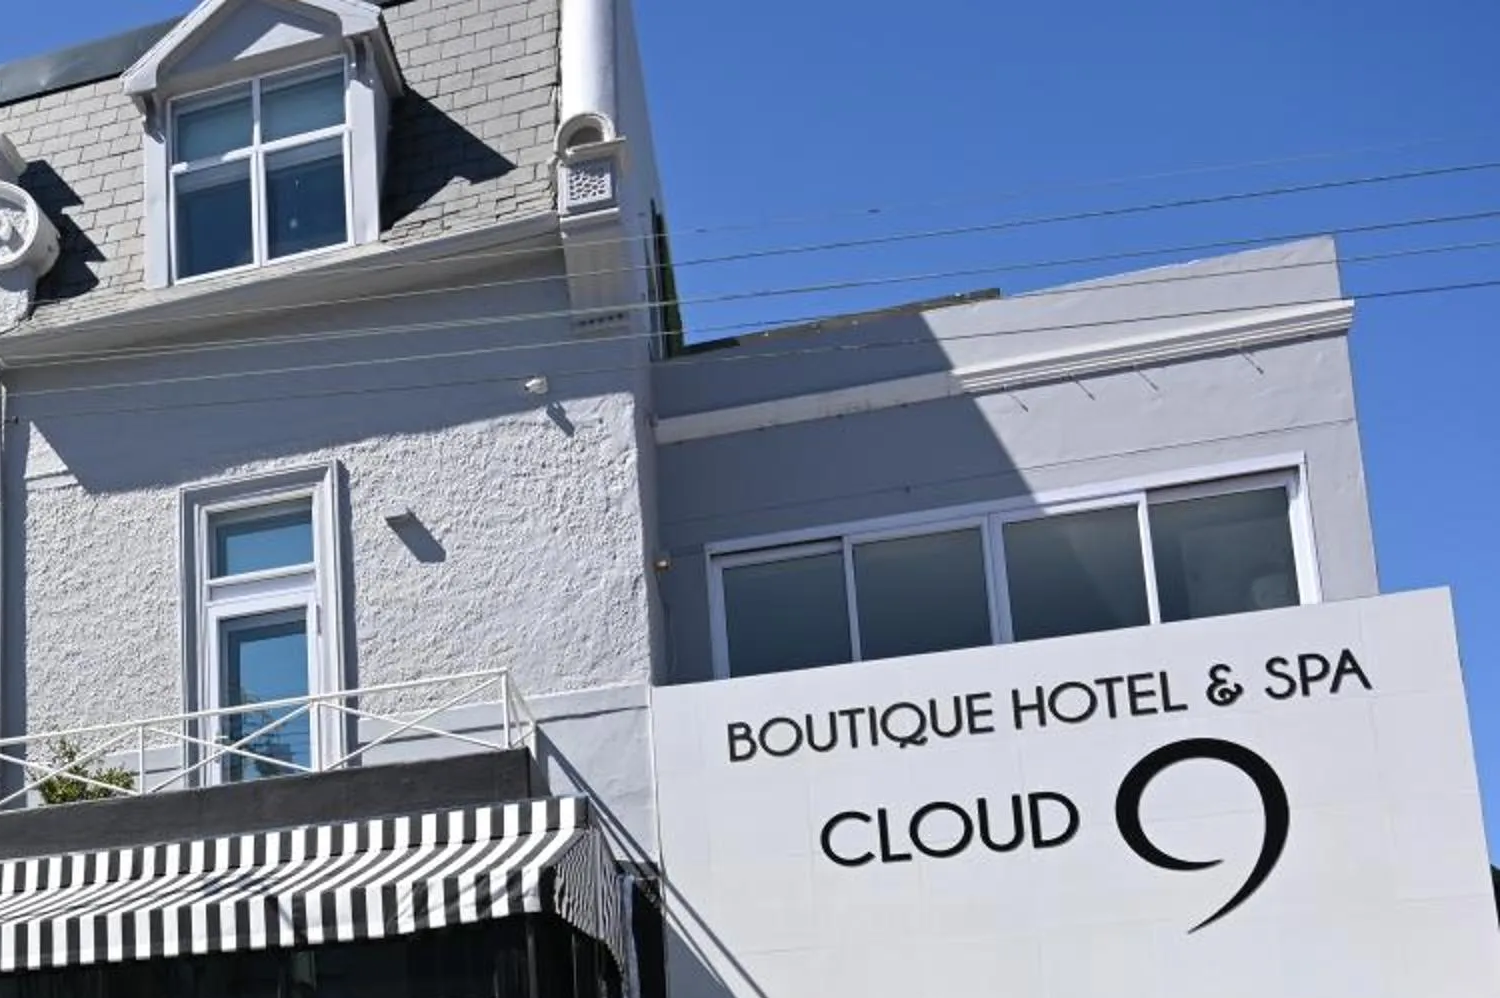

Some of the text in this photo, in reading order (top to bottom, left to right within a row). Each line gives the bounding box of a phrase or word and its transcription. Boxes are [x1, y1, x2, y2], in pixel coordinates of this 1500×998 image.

[727, 648, 1373, 763] BOUTIQUE HOTEL & SPA
[819, 737, 1291, 935] CLOUD 9
